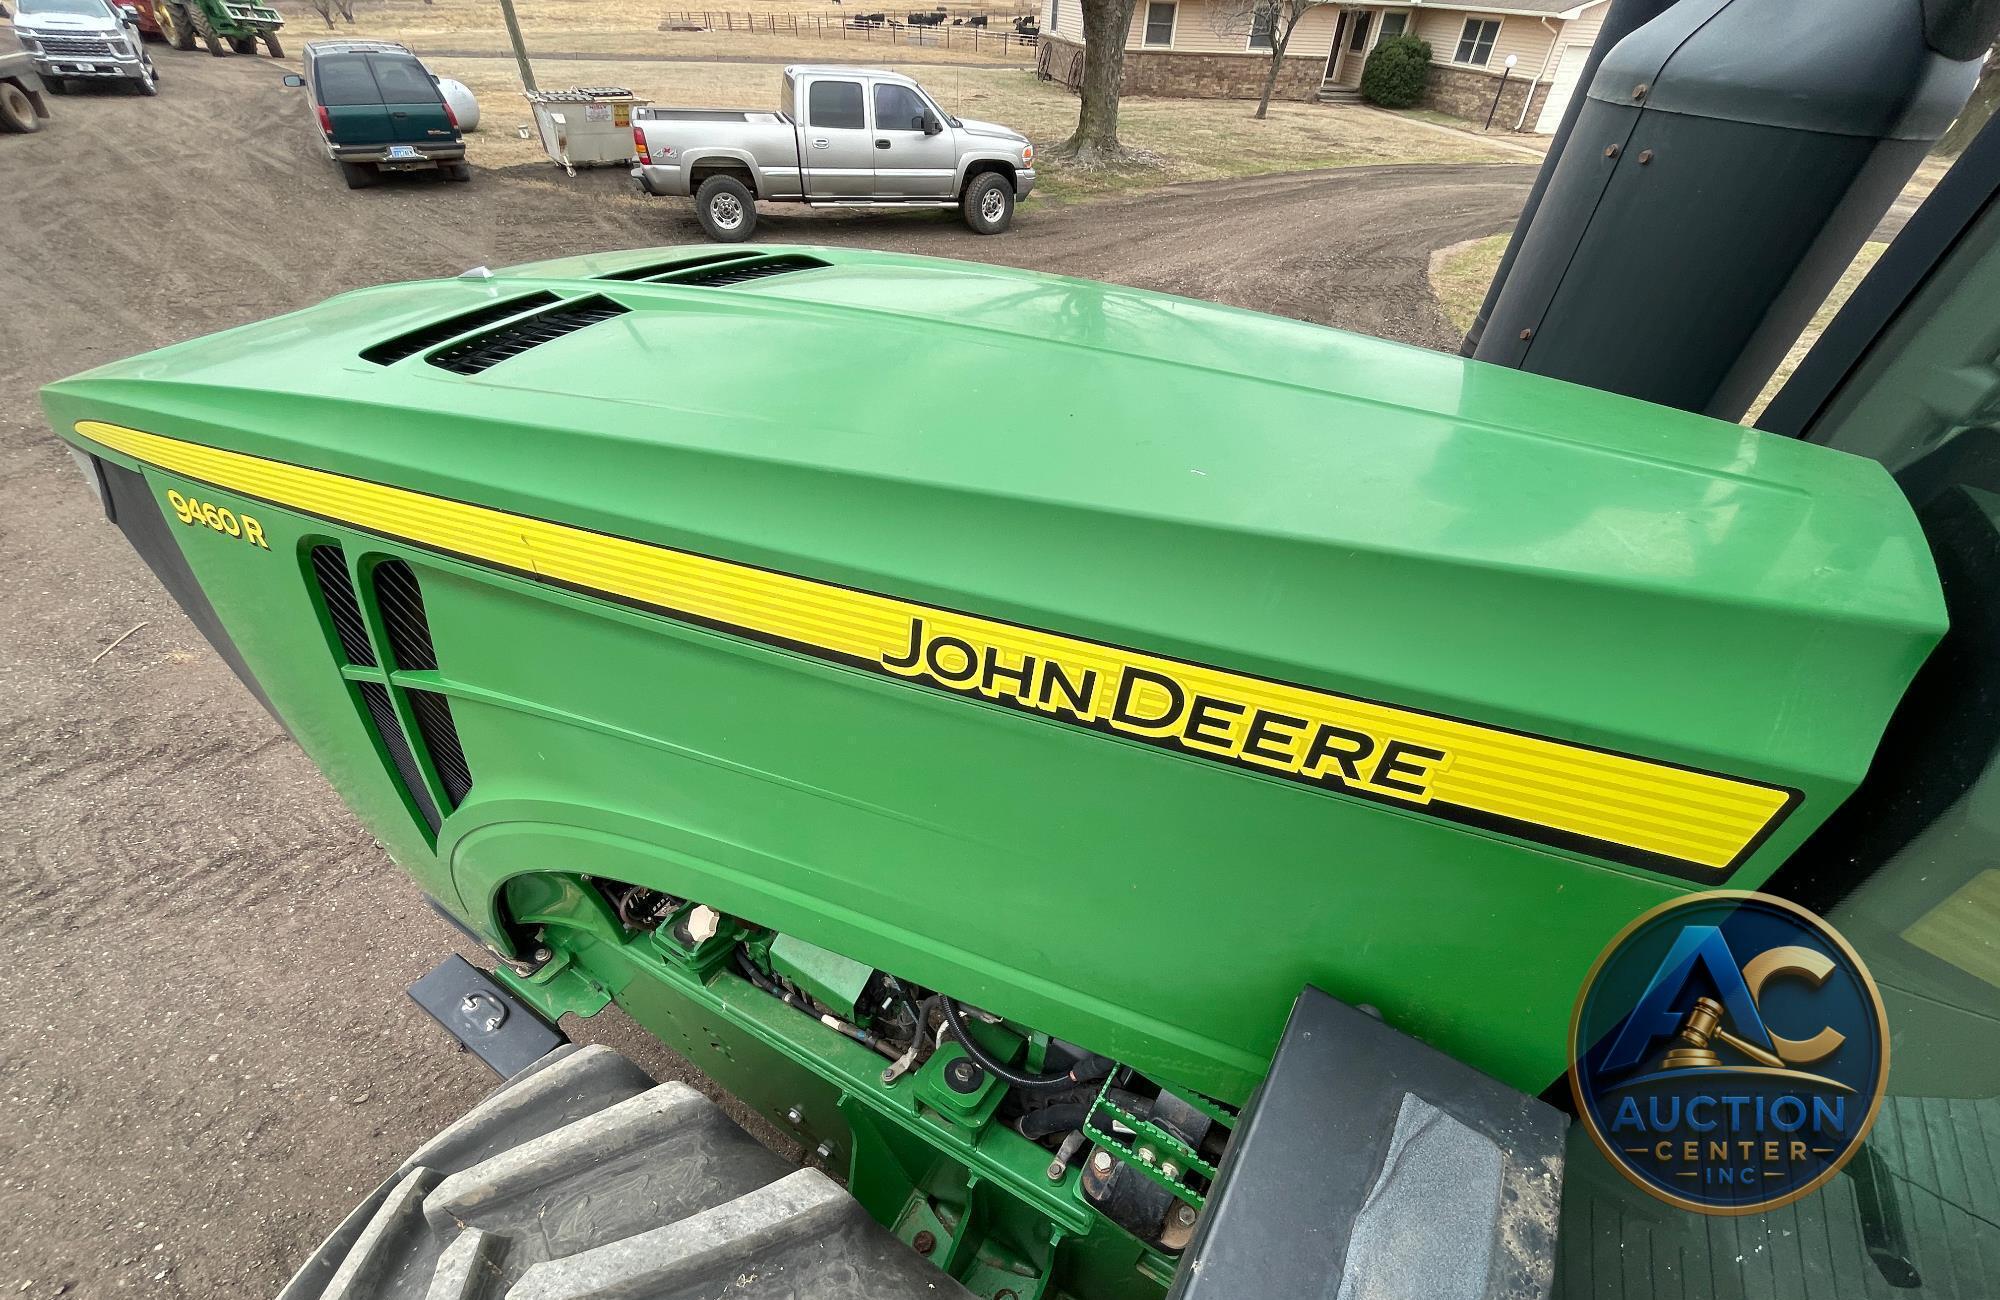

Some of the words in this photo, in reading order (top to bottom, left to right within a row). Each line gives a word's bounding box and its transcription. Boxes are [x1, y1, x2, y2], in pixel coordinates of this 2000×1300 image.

[167, 488, 241, 538] 9460
[241, 514, 271, 550] R
[881, 617, 1097, 714] JOHN
[1110, 664, 1447, 798] DEERE
